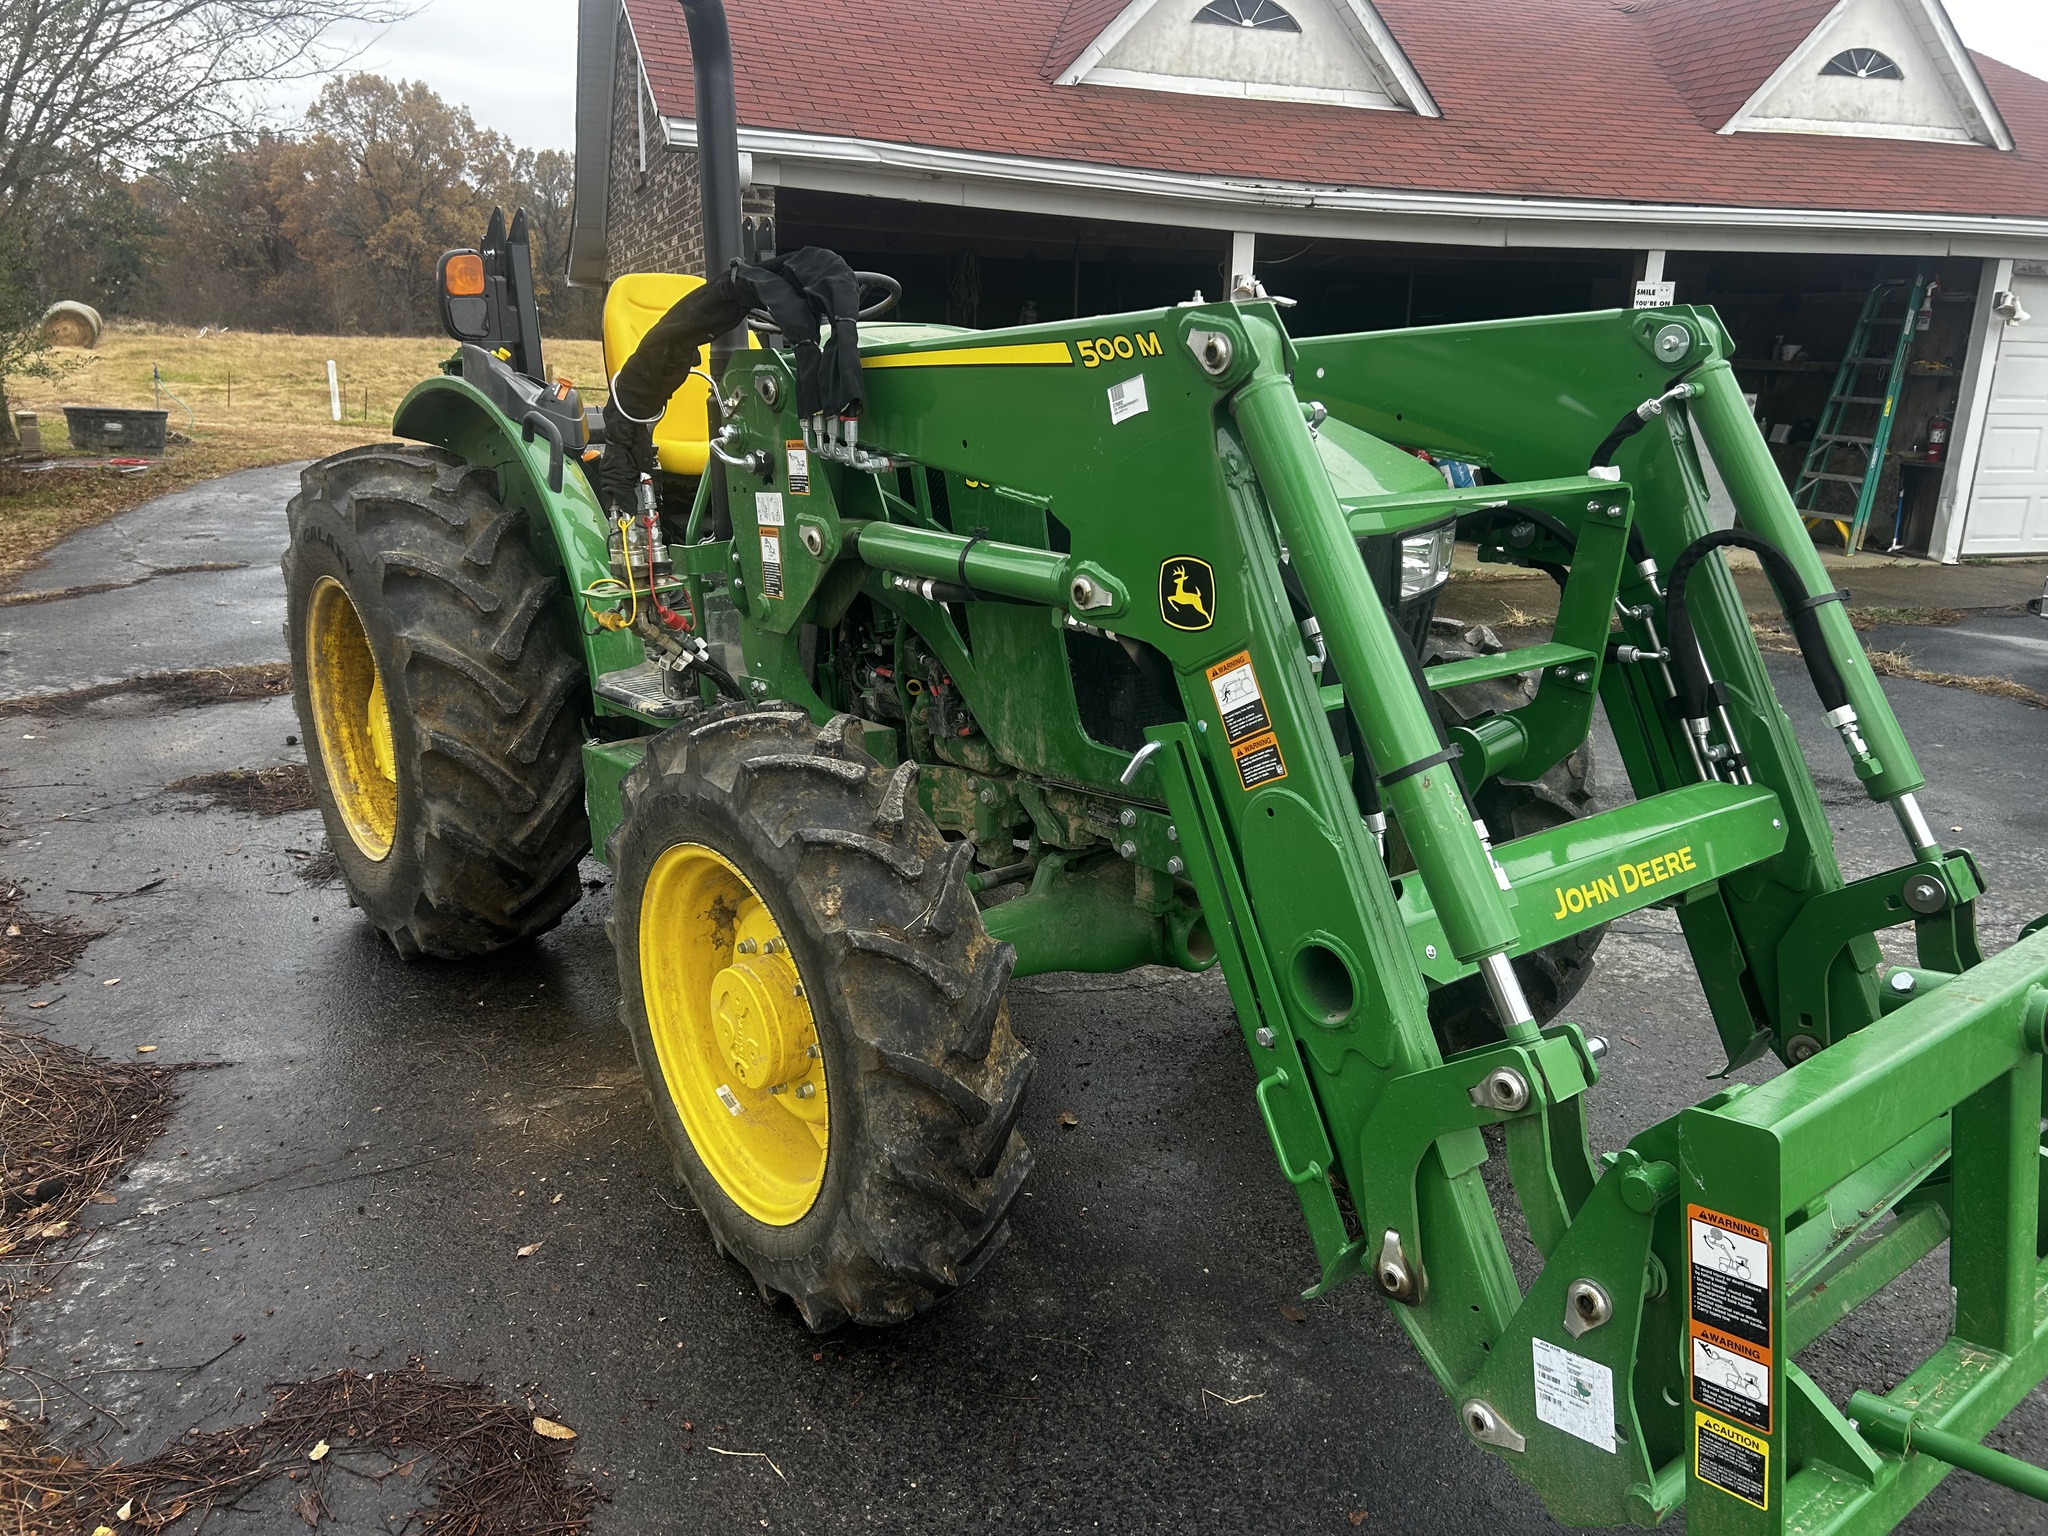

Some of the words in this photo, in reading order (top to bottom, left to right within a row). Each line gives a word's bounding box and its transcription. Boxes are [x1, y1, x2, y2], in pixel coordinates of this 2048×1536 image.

[1636, 288, 1656, 296] SMILE
[1075, 335, 1134, 368] 500
[1134, 331, 1164, 357] M
[1217, 656, 1246, 674] WARNING
[1243, 737, 1272, 753] WARNING
[1554, 874, 1620, 920] JOHN
[1617, 846, 1697, 894] DEERE
[1707, 1213, 1759, 1237] WARNING
[1710, 1333, 1760, 1359] WARNING
[1713, 1423, 1759, 1450] CAUTION
